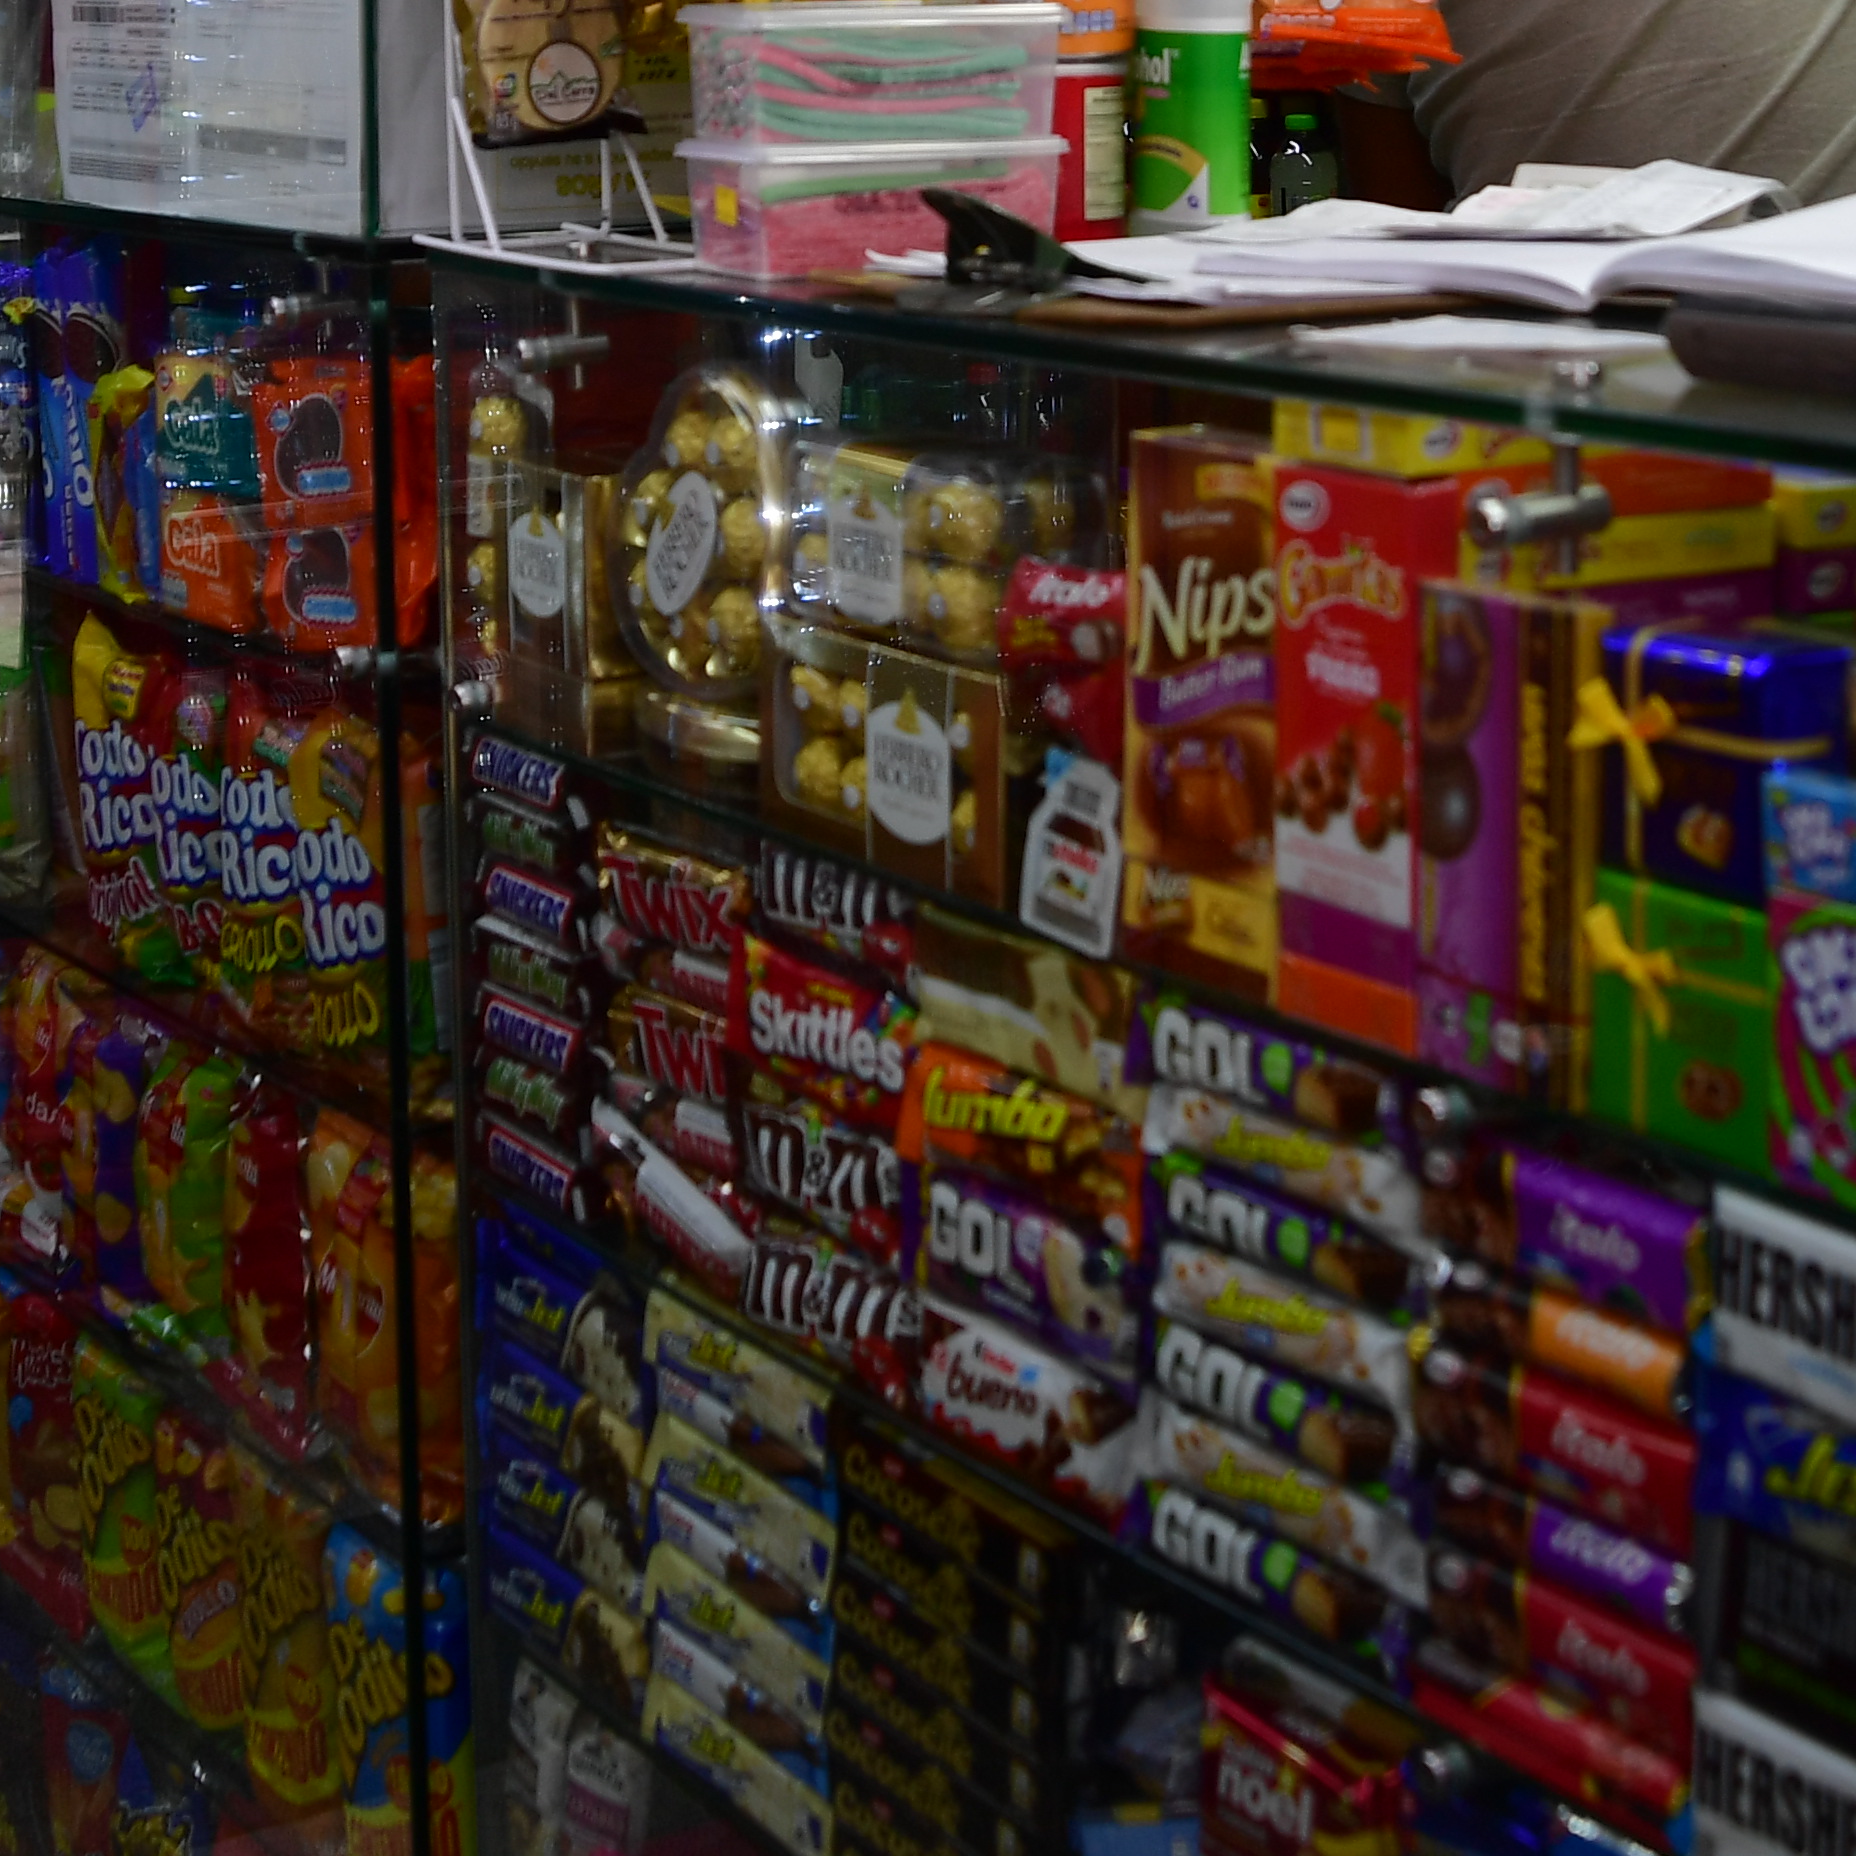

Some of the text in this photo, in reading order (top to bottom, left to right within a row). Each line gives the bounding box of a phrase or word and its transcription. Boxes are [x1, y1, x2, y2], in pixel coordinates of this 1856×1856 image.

[1138, 554, 1275, 678] Nips
[487, 864, 572, 939] SNICKERS
[602, 855, 739, 946] TWIX
[486, 996, 579, 1070] SNICKERS
[748, 988, 906, 1093] Skittles
[927, 1179, 1036, 1301] GOL
[943, 1358, 1038, 1421] bueno
